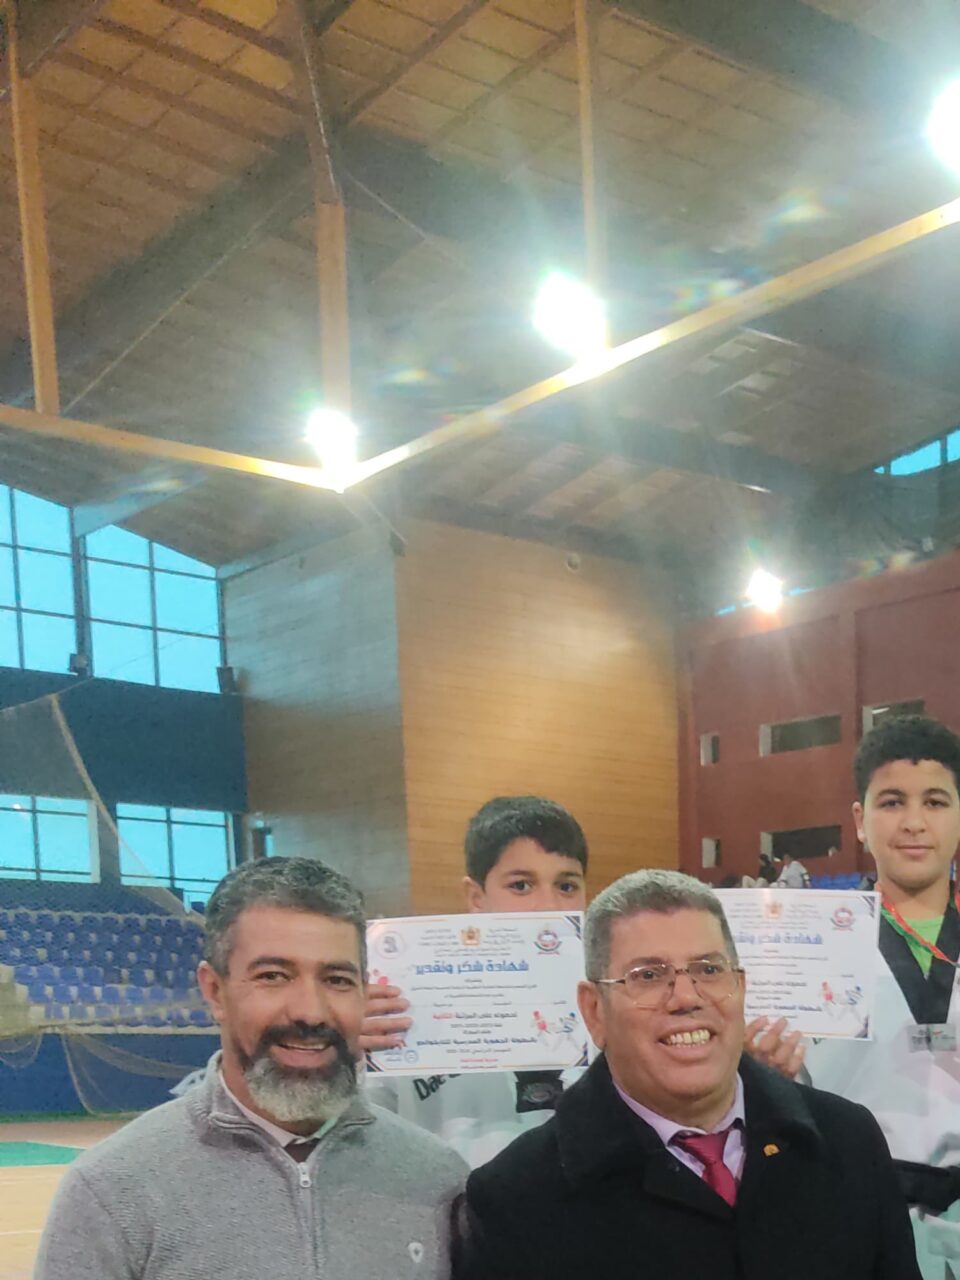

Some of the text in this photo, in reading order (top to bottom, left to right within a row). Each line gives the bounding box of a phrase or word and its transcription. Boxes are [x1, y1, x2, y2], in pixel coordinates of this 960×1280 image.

[416, 959, 529, 976] شهادة شكر وتقدير
